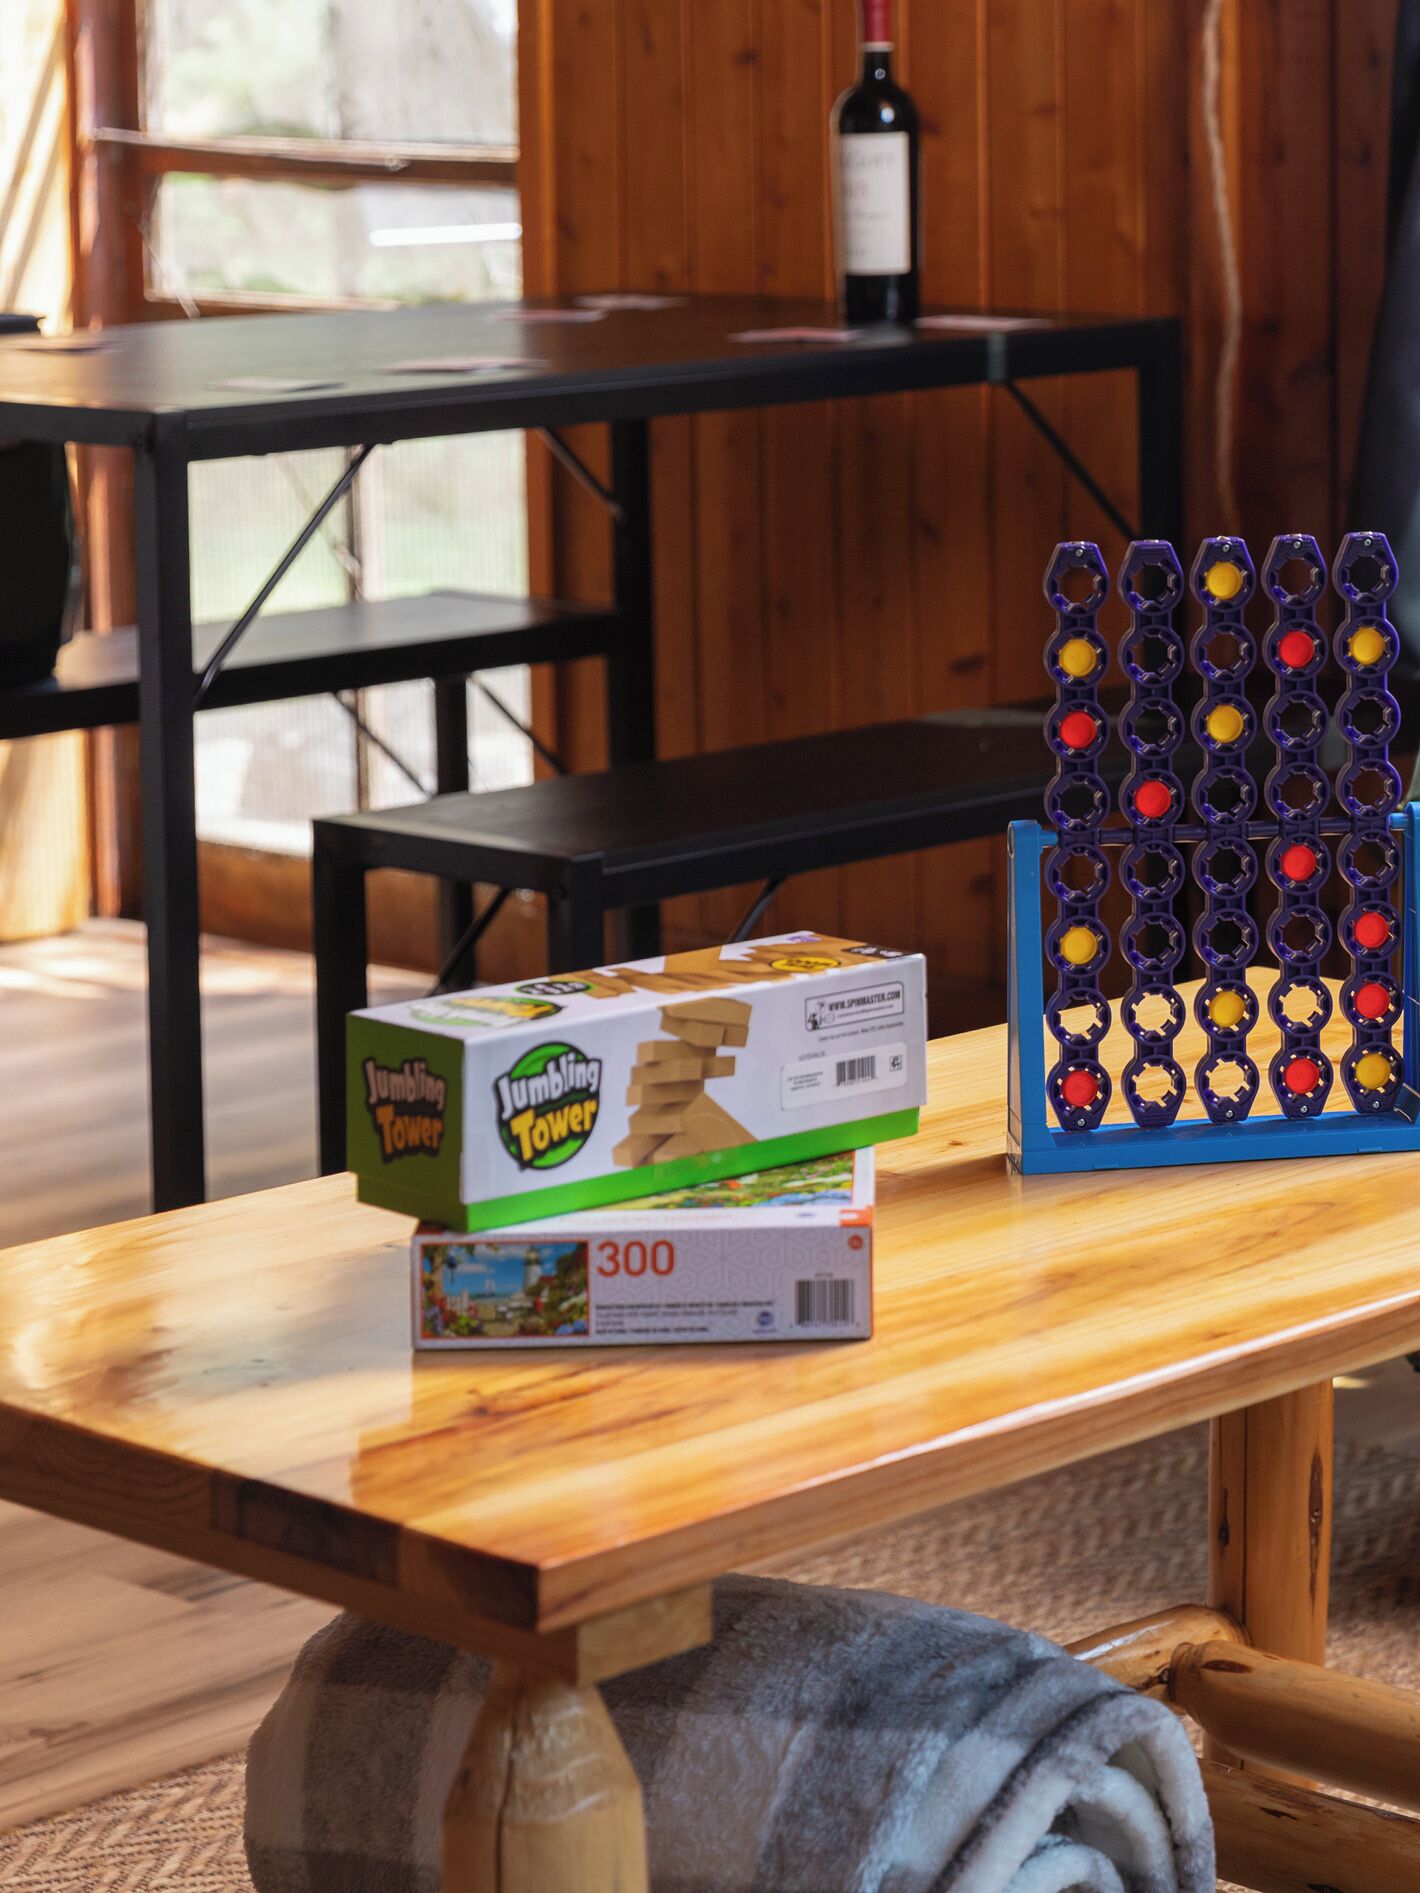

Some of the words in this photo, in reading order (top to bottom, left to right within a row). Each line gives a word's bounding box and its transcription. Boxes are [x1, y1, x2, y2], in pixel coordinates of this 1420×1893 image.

[828, 990, 901, 1011] WWW.SPINMASTER.COM
[364, 1058, 447, 1112] Jumbling
[497, 1052, 601, 1120] Jumbling
[375, 1104, 444, 1155] Tower
[510, 1099, 598, 1161] Tower
[596, 1240, 675, 1278] 300
